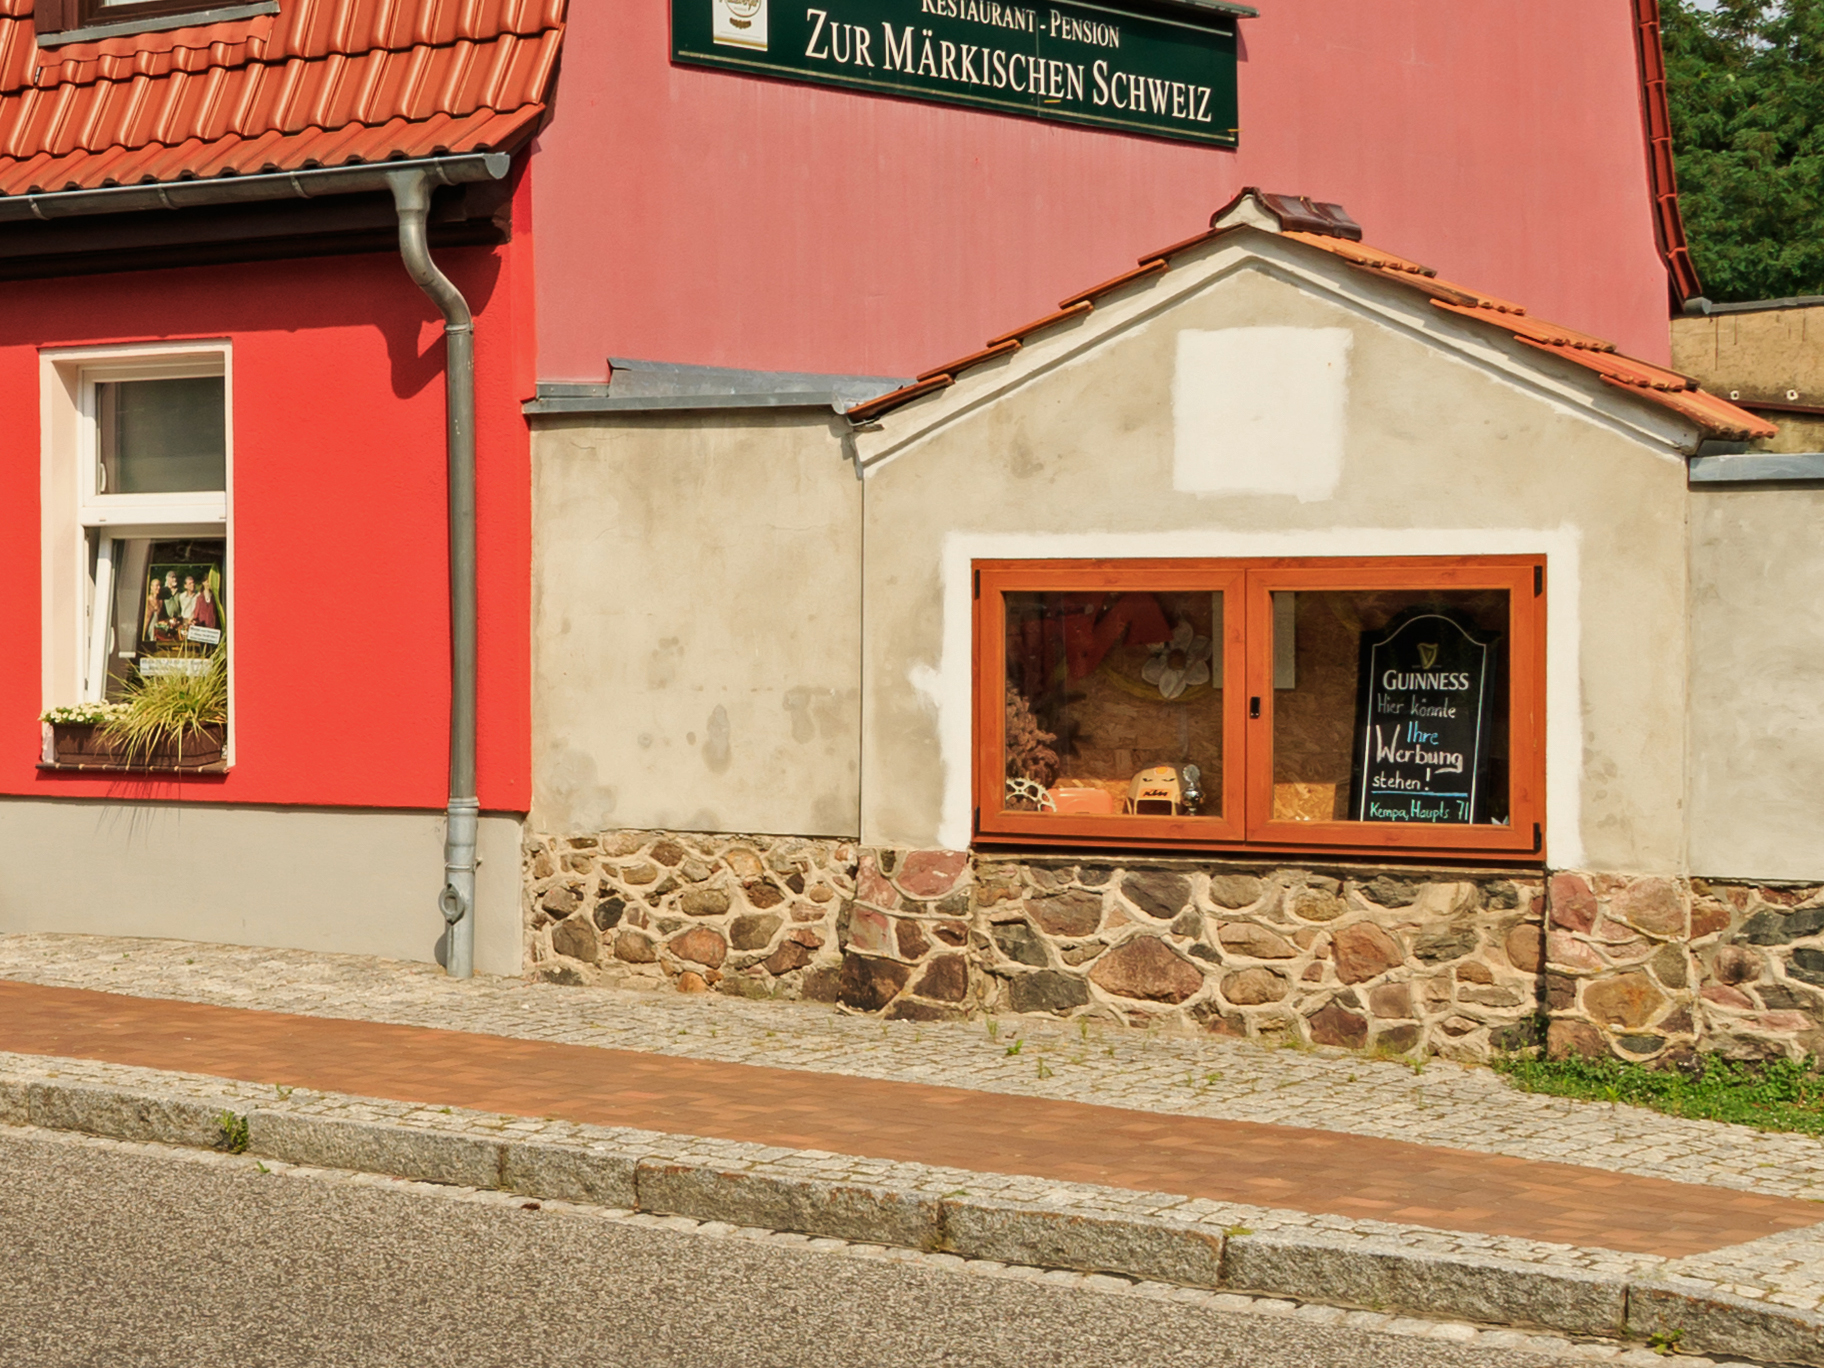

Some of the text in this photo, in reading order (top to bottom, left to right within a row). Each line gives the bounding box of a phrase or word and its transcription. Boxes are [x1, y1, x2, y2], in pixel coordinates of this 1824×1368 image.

[1049, 9, 1120, 48] PENSION
[805, 8, 1213, 123] ZUR MÄRKISCHEN SCHWEIZ
[1383, 670, 1469, 690] GUINNESS
[1377, 693, 1456, 718] Hier könnte
[1406, 721, 1439, 745] Ihre
[1376, 724, 1463, 773] Werbung
[1456, 799, 1469, 821] 71
